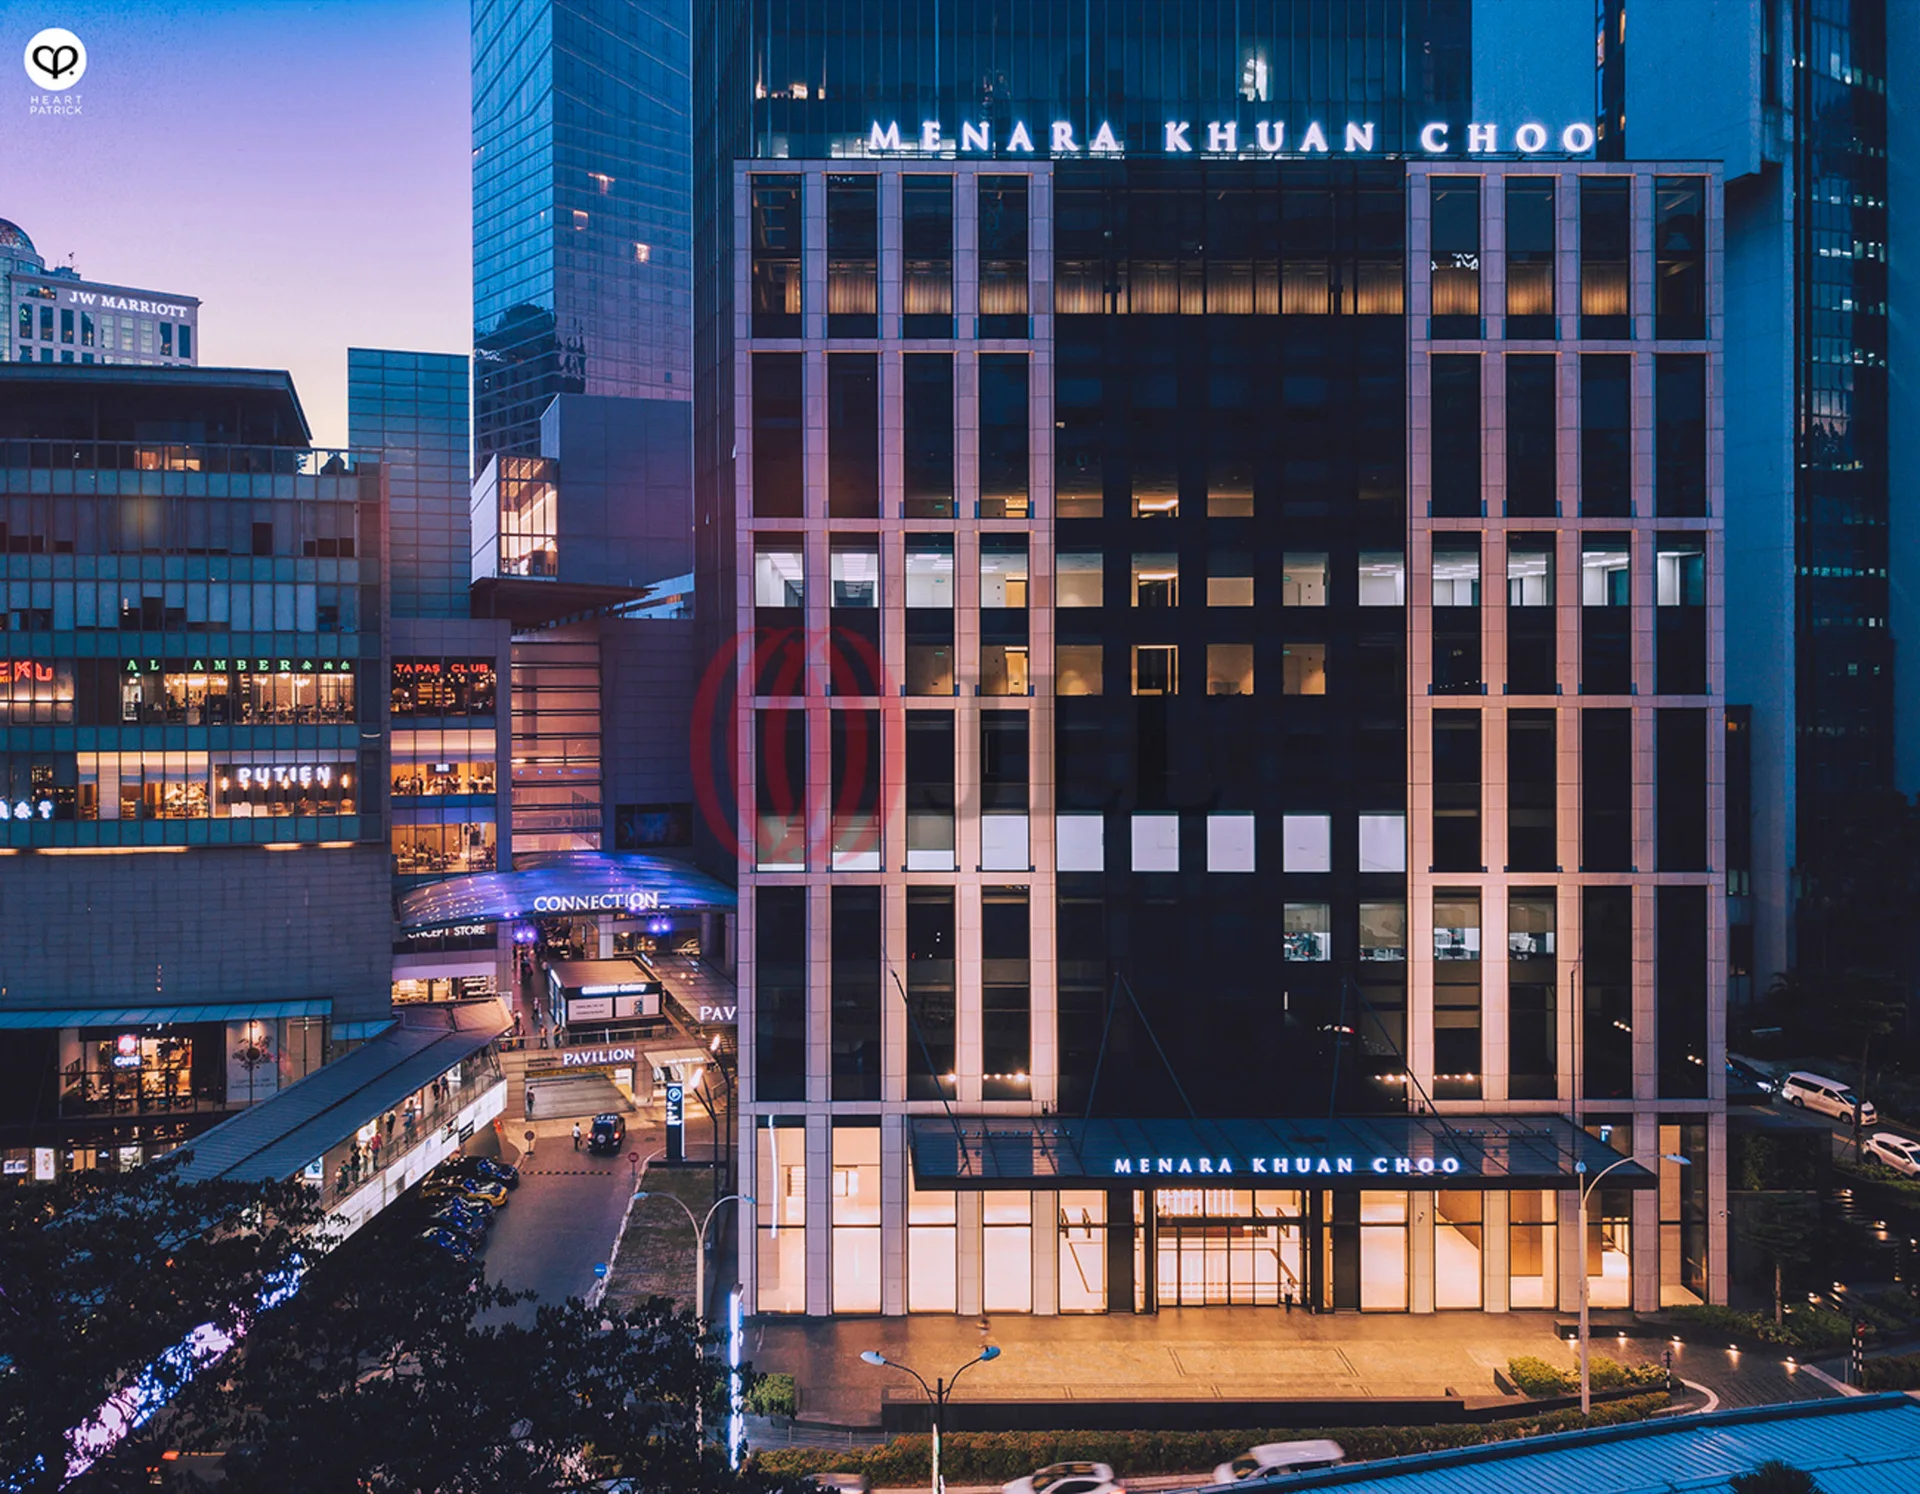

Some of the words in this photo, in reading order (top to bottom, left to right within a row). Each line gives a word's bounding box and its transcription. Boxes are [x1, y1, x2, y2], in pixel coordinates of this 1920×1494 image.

[868, 120, 1122, 152] MENARA
[1164, 120, 1375, 152] KHUAN
[1420, 122, 1594, 152] CHOO
[69, 290, 97, 305] JW
[101, 295, 188, 318] MARRIOTT
[126, 659, 160, 671] AL
[192, 659, 291, 671] AMBER
[395, 663, 441, 674] TAPAS
[450, 663, 489, 674] CLUB
[237, 766, 331, 784] PUTIEN
[534, 891, 659, 913] CONNECTION
[453, 924, 486, 937] STORE
[562, 1048, 636, 1066] PAVILION
[1114, 1157, 1233, 1174] MENARA
[1252, 1157, 1354, 1174] KHUAN
[1373, 1157, 1460, 1174] CHOO
